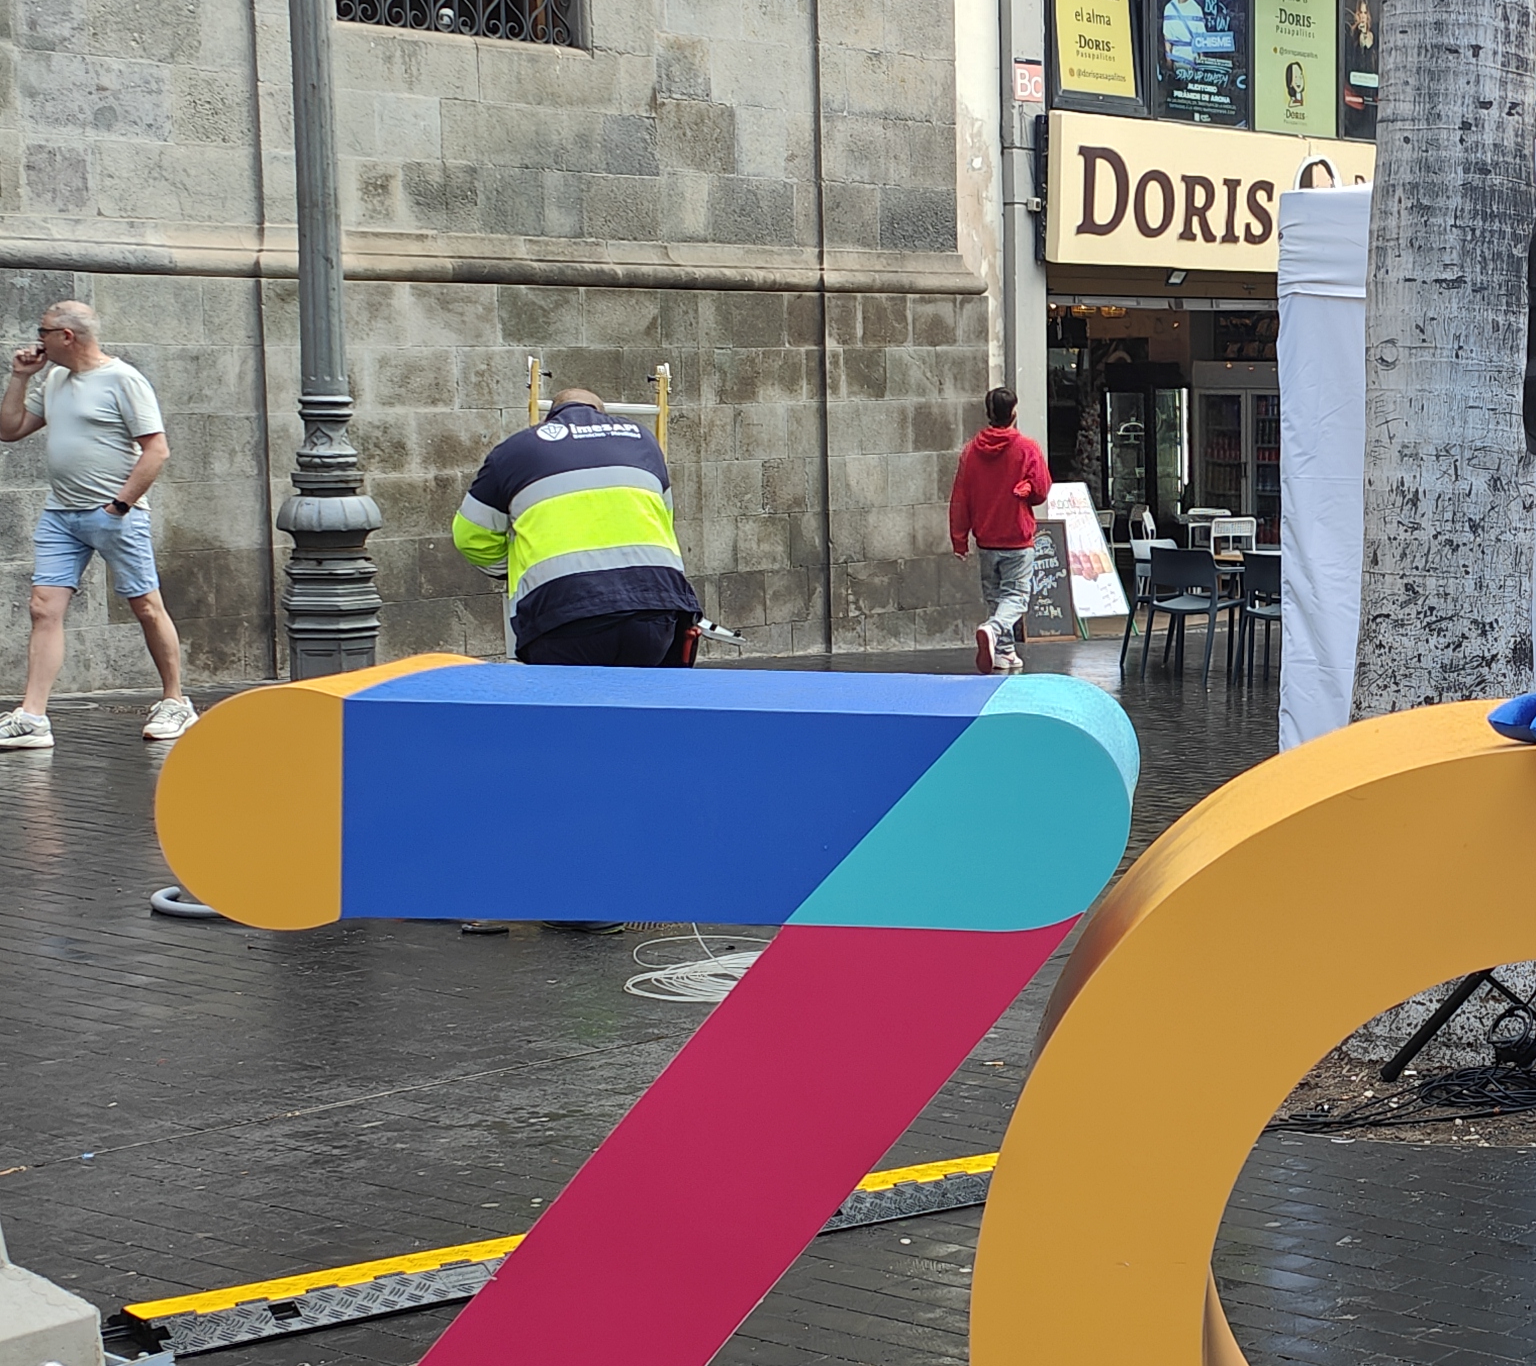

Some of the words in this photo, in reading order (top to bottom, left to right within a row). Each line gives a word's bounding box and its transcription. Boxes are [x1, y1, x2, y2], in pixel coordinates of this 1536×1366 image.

[1075, 7, 1084, 22] el
[1086, 10, 1111, 26] alma
[1195, 37, 1231, 47] CHISME
[1076, 146, 1275, 244] DORIS
